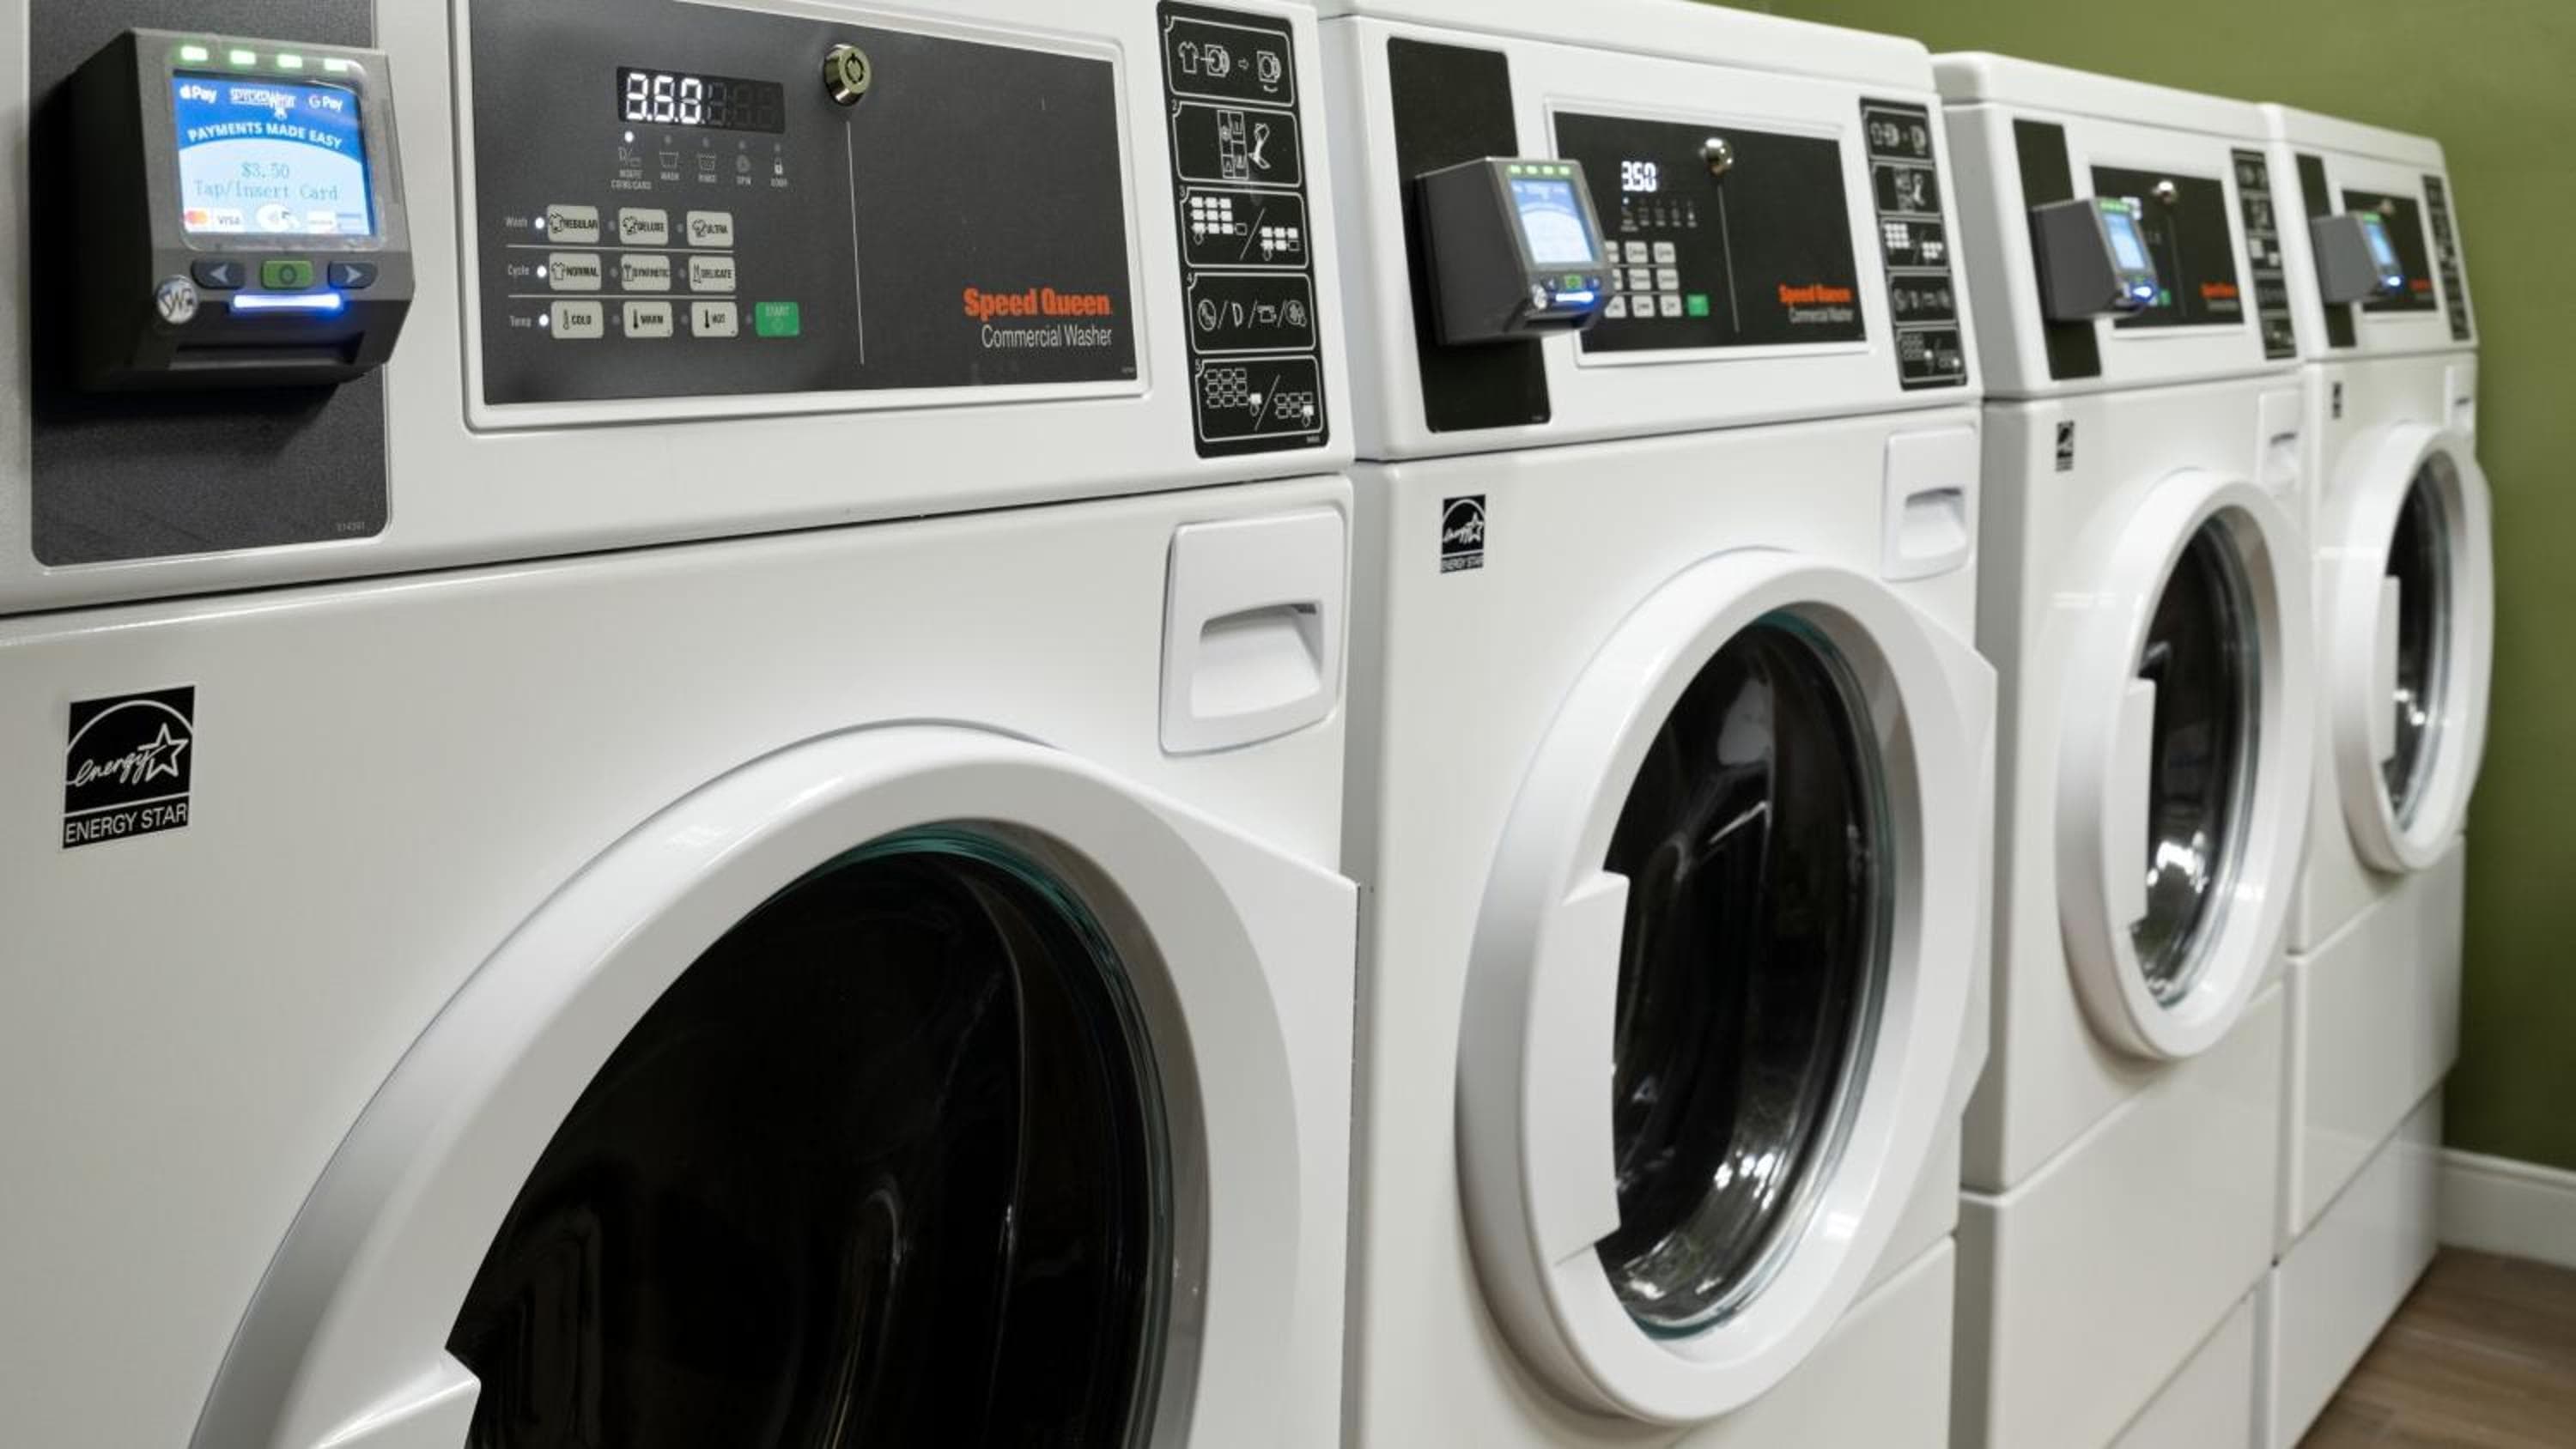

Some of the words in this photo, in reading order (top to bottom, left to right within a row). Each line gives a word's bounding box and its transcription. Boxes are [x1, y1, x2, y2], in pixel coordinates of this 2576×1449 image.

[191, 86, 217, 104] Pay
[322, 96, 343, 111] Pay
[187, 121, 263, 142] PAYMENTS
[265, 123, 306, 140] MADE
[308, 130, 343, 149] EASY
[240, 162, 290, 179] $3.50
[194, 179, 289, 198] Tap/Insert
[301, 184, 339, 201] Card
[507, 264, 530, 278] Cycle
[567, 266, 600, 277] NORMAL
[963, 287, 1038, 322] Speed
[1041, 287, 1111, 317] Queen
[571, 315, 592, 325] COLD
[641, 315, 664, 324] WARM
[981, 324, 1062, 349] Commercial
[1064, 324, 1113, 347] Washer
[64, 811, 137, 844] ENERGY
[141, 803, 187, 830] STAR
